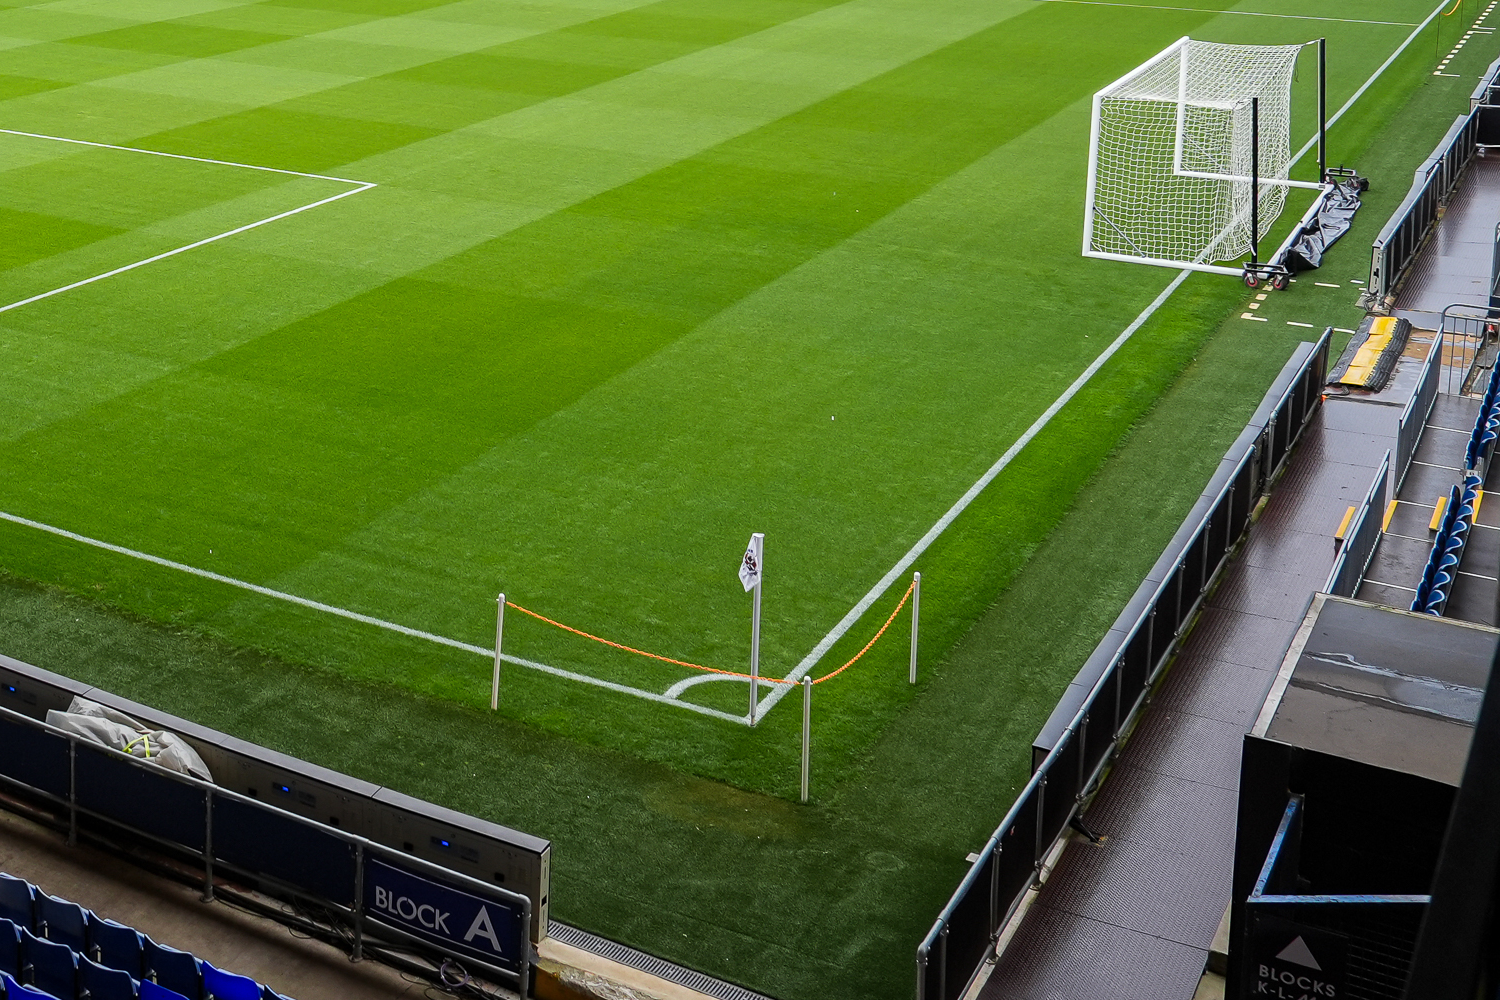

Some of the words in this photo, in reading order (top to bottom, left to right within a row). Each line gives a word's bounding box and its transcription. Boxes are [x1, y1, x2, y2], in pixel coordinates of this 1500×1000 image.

[375, 885, 451, 935] BLOCK
[463, 904, 502, 953] A
[1258, 963, 1336, 998] BLOCKS
